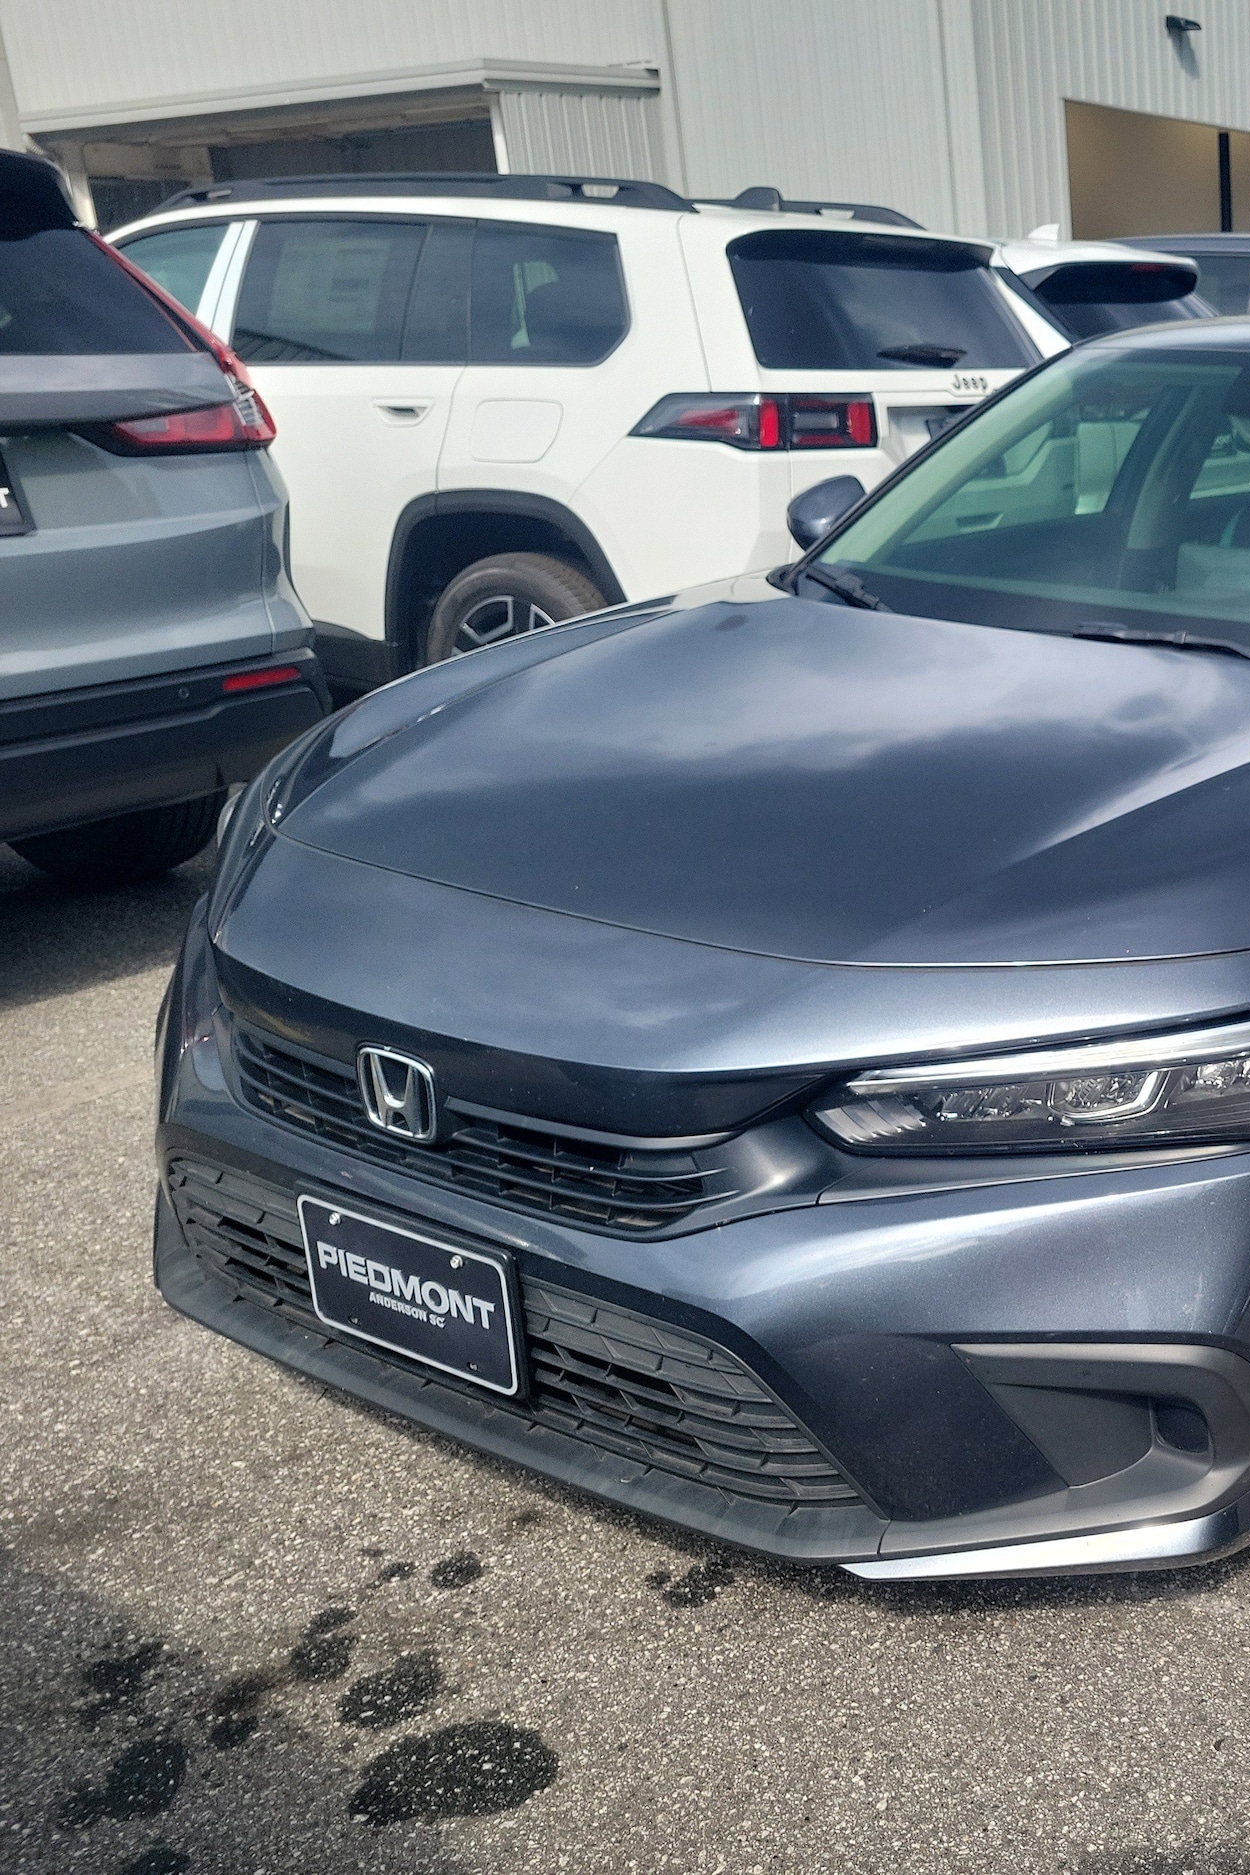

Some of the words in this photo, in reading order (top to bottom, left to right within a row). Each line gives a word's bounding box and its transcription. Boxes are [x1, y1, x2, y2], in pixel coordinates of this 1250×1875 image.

[952, 373, 988, 394] Jeep
[316, 1240, 495, 1330] PIEDMONT
[369, 1291, 428, 1323] ANDERSON
[428, 1313, 446, 1329] SC
